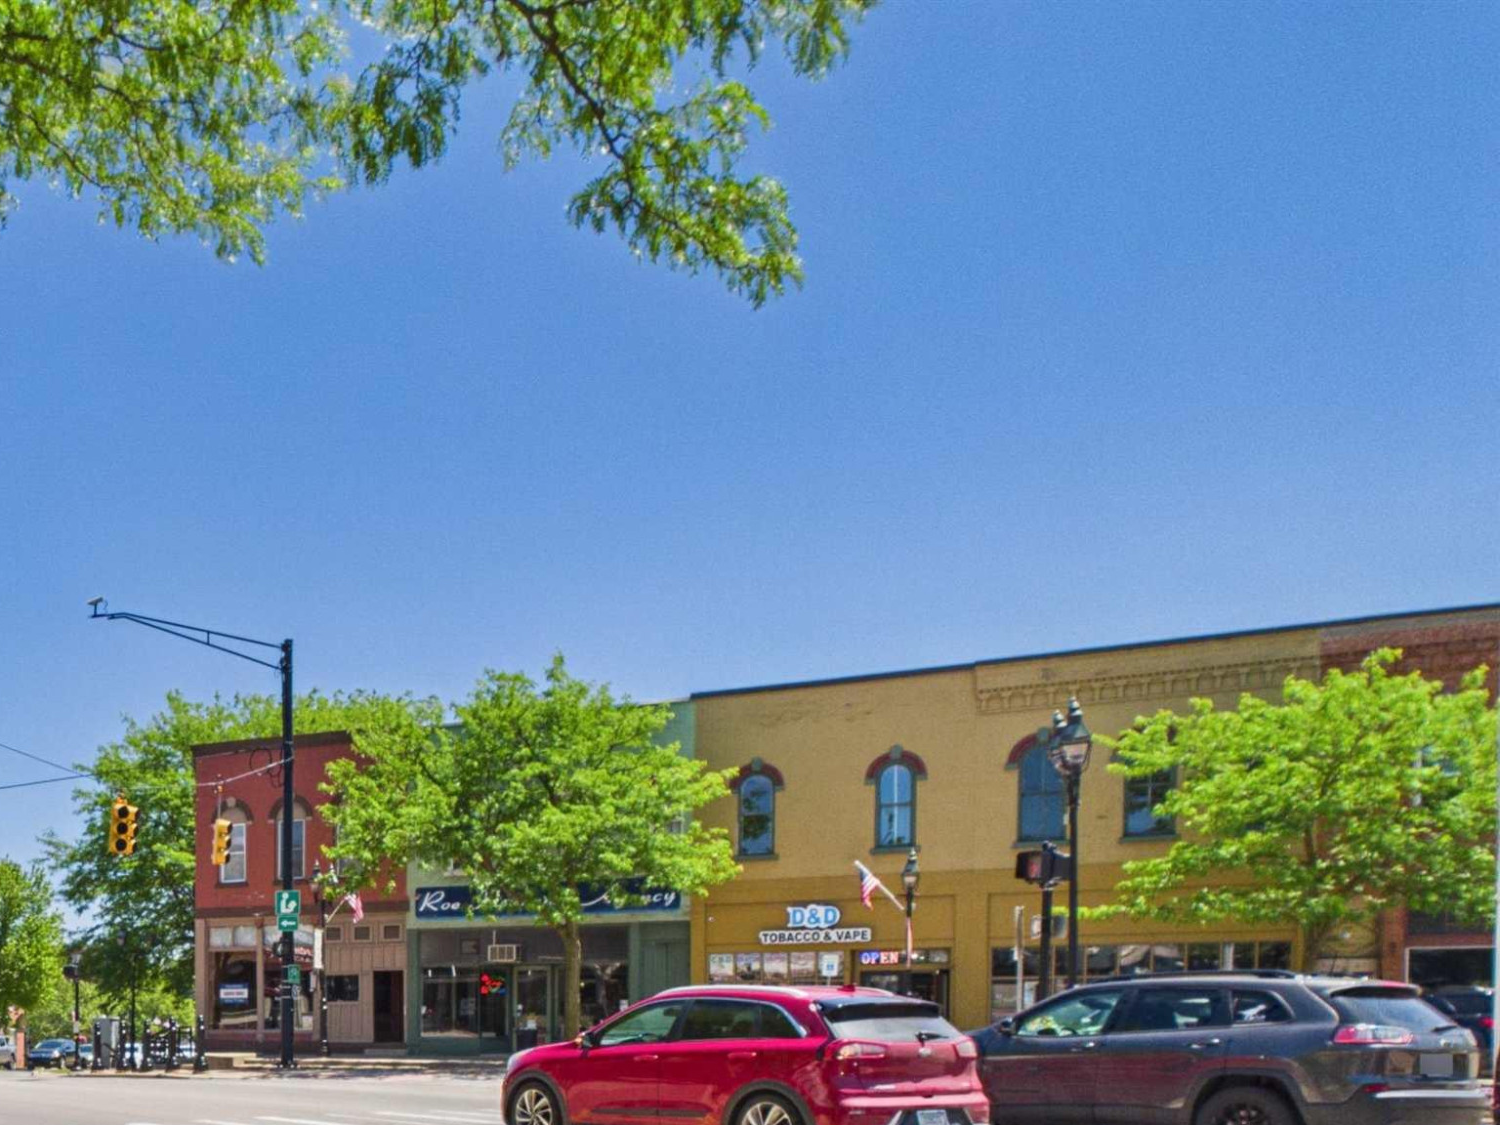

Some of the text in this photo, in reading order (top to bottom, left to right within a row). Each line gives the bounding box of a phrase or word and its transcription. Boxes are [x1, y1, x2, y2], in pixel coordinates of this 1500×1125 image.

[418, 890, 461, 912] Roe
[789, 906, 839, 927] D&D
[762, 929, 869, 943] TOBACCO & VAPE
[861, 951, 899, 964] OPEN
